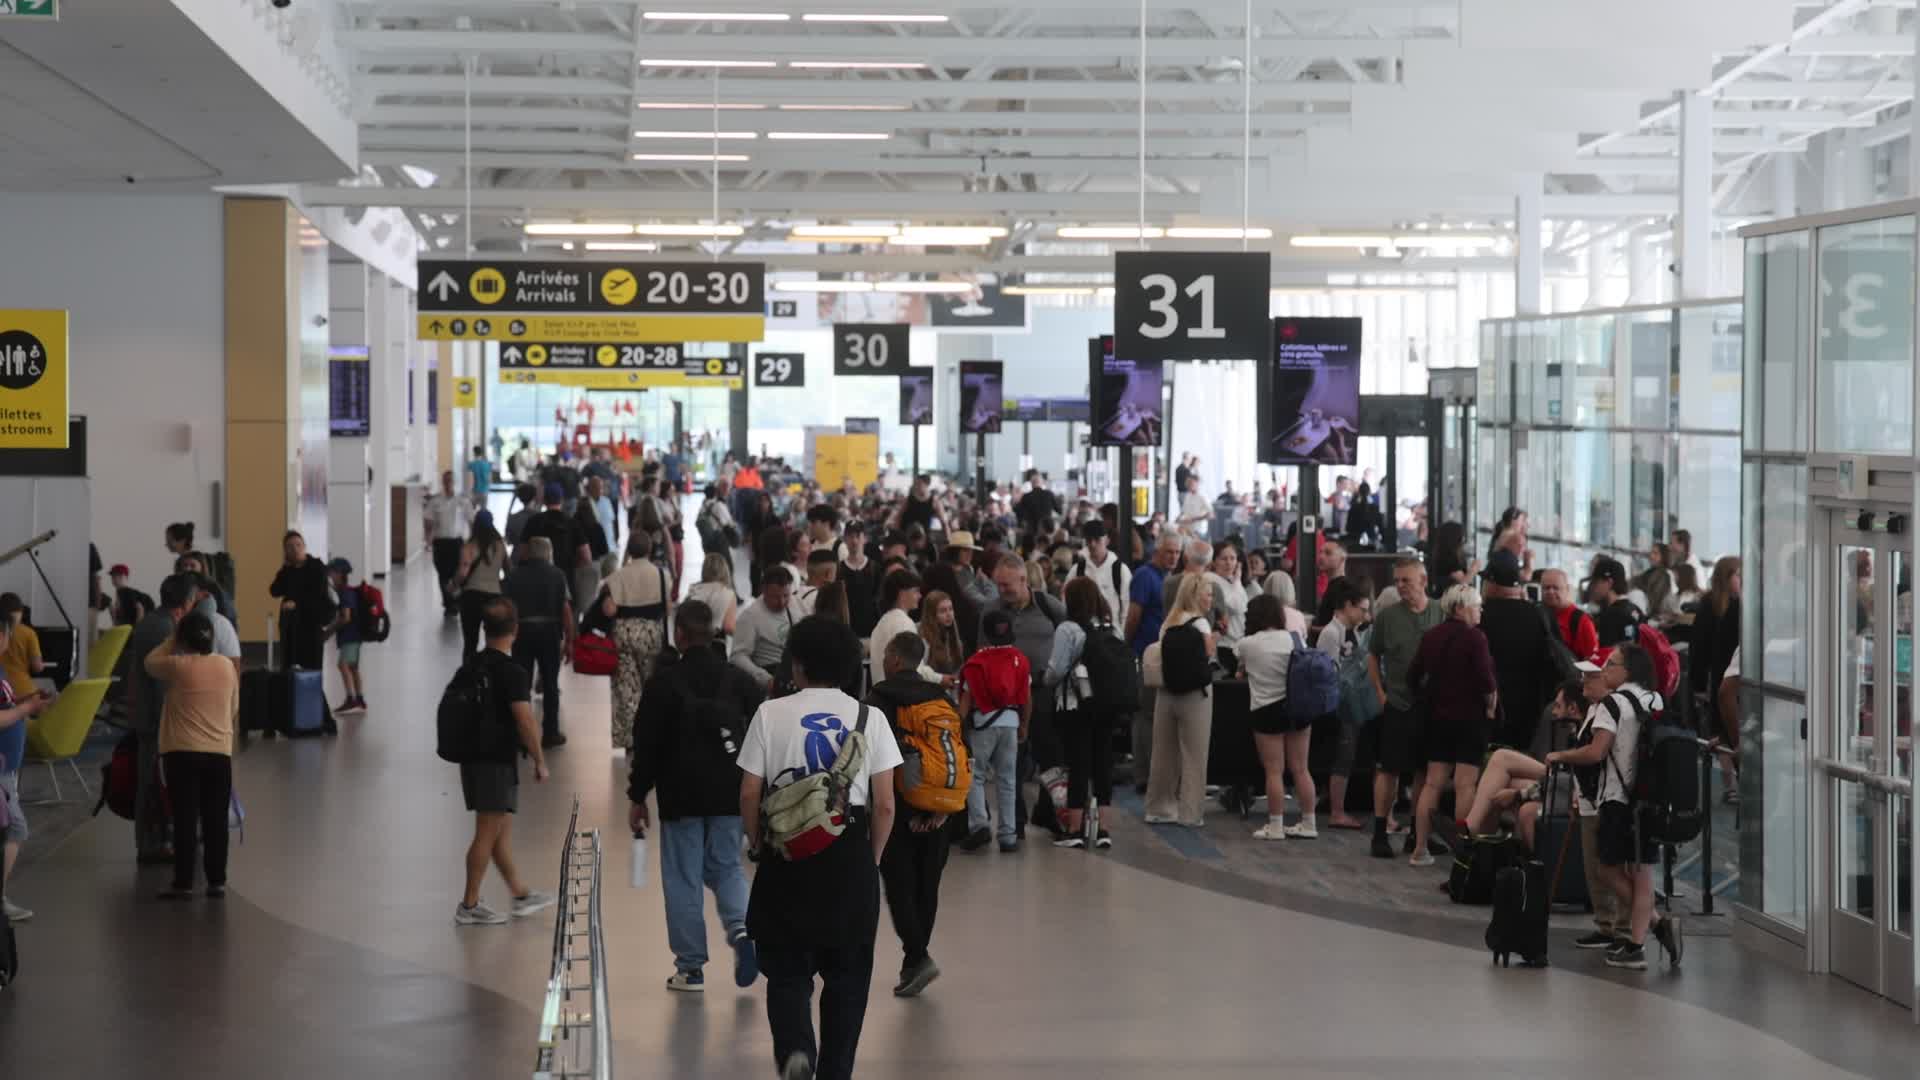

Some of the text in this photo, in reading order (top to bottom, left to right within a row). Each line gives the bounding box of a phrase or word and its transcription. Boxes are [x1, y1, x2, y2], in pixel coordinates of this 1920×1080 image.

[515, 269, 580, 286] Arrivées
[646, 271, 750, 305] 20-30
[515, 287, 577, 304] Arrivals
[1137, 272, 1227, 340] 31
[620, 346, 678, 366] 20-28
[843, 332, 889, 368] 30
[759, 357, 793, 383] 29
[1, 423, 53, 435] strooms
